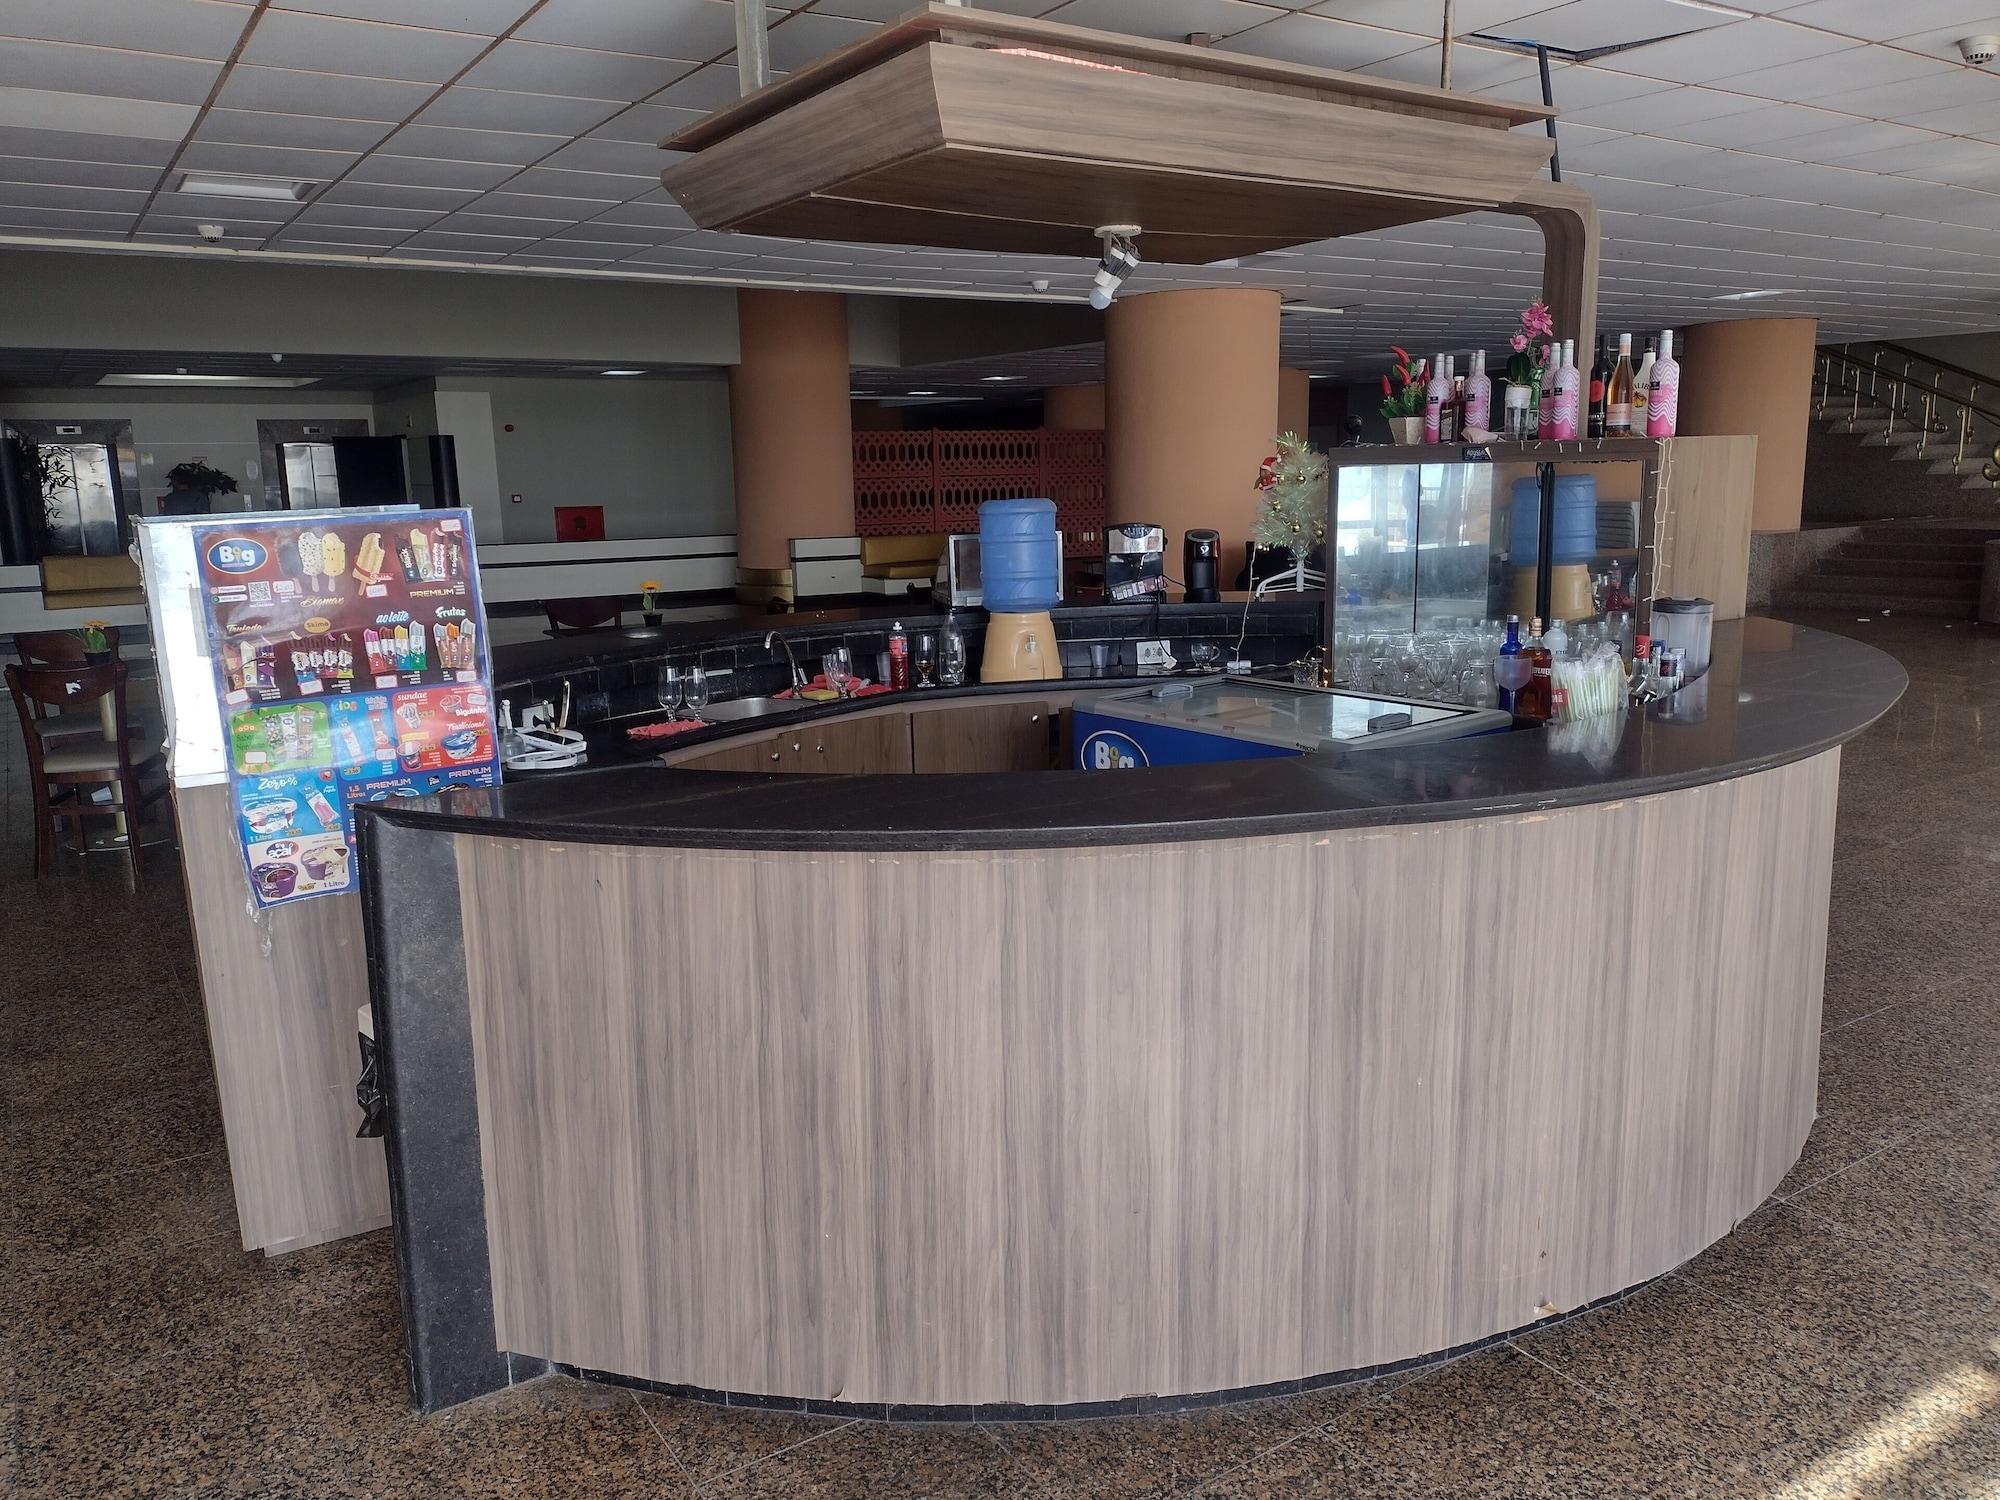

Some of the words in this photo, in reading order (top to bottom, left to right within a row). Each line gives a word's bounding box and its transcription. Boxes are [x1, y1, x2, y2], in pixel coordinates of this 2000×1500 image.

[218, 545, 256, 566] Big
[409, 588, 455, 598] PREMIUM
[435, 606, 466, 619] Frutas
[396, 692, 428, 701] sundae
[455, 706, 487, 717] Biguinho
[449, 766, 492, 779] PREMIUM
[366, 778, 412, 791] PREMIUM
